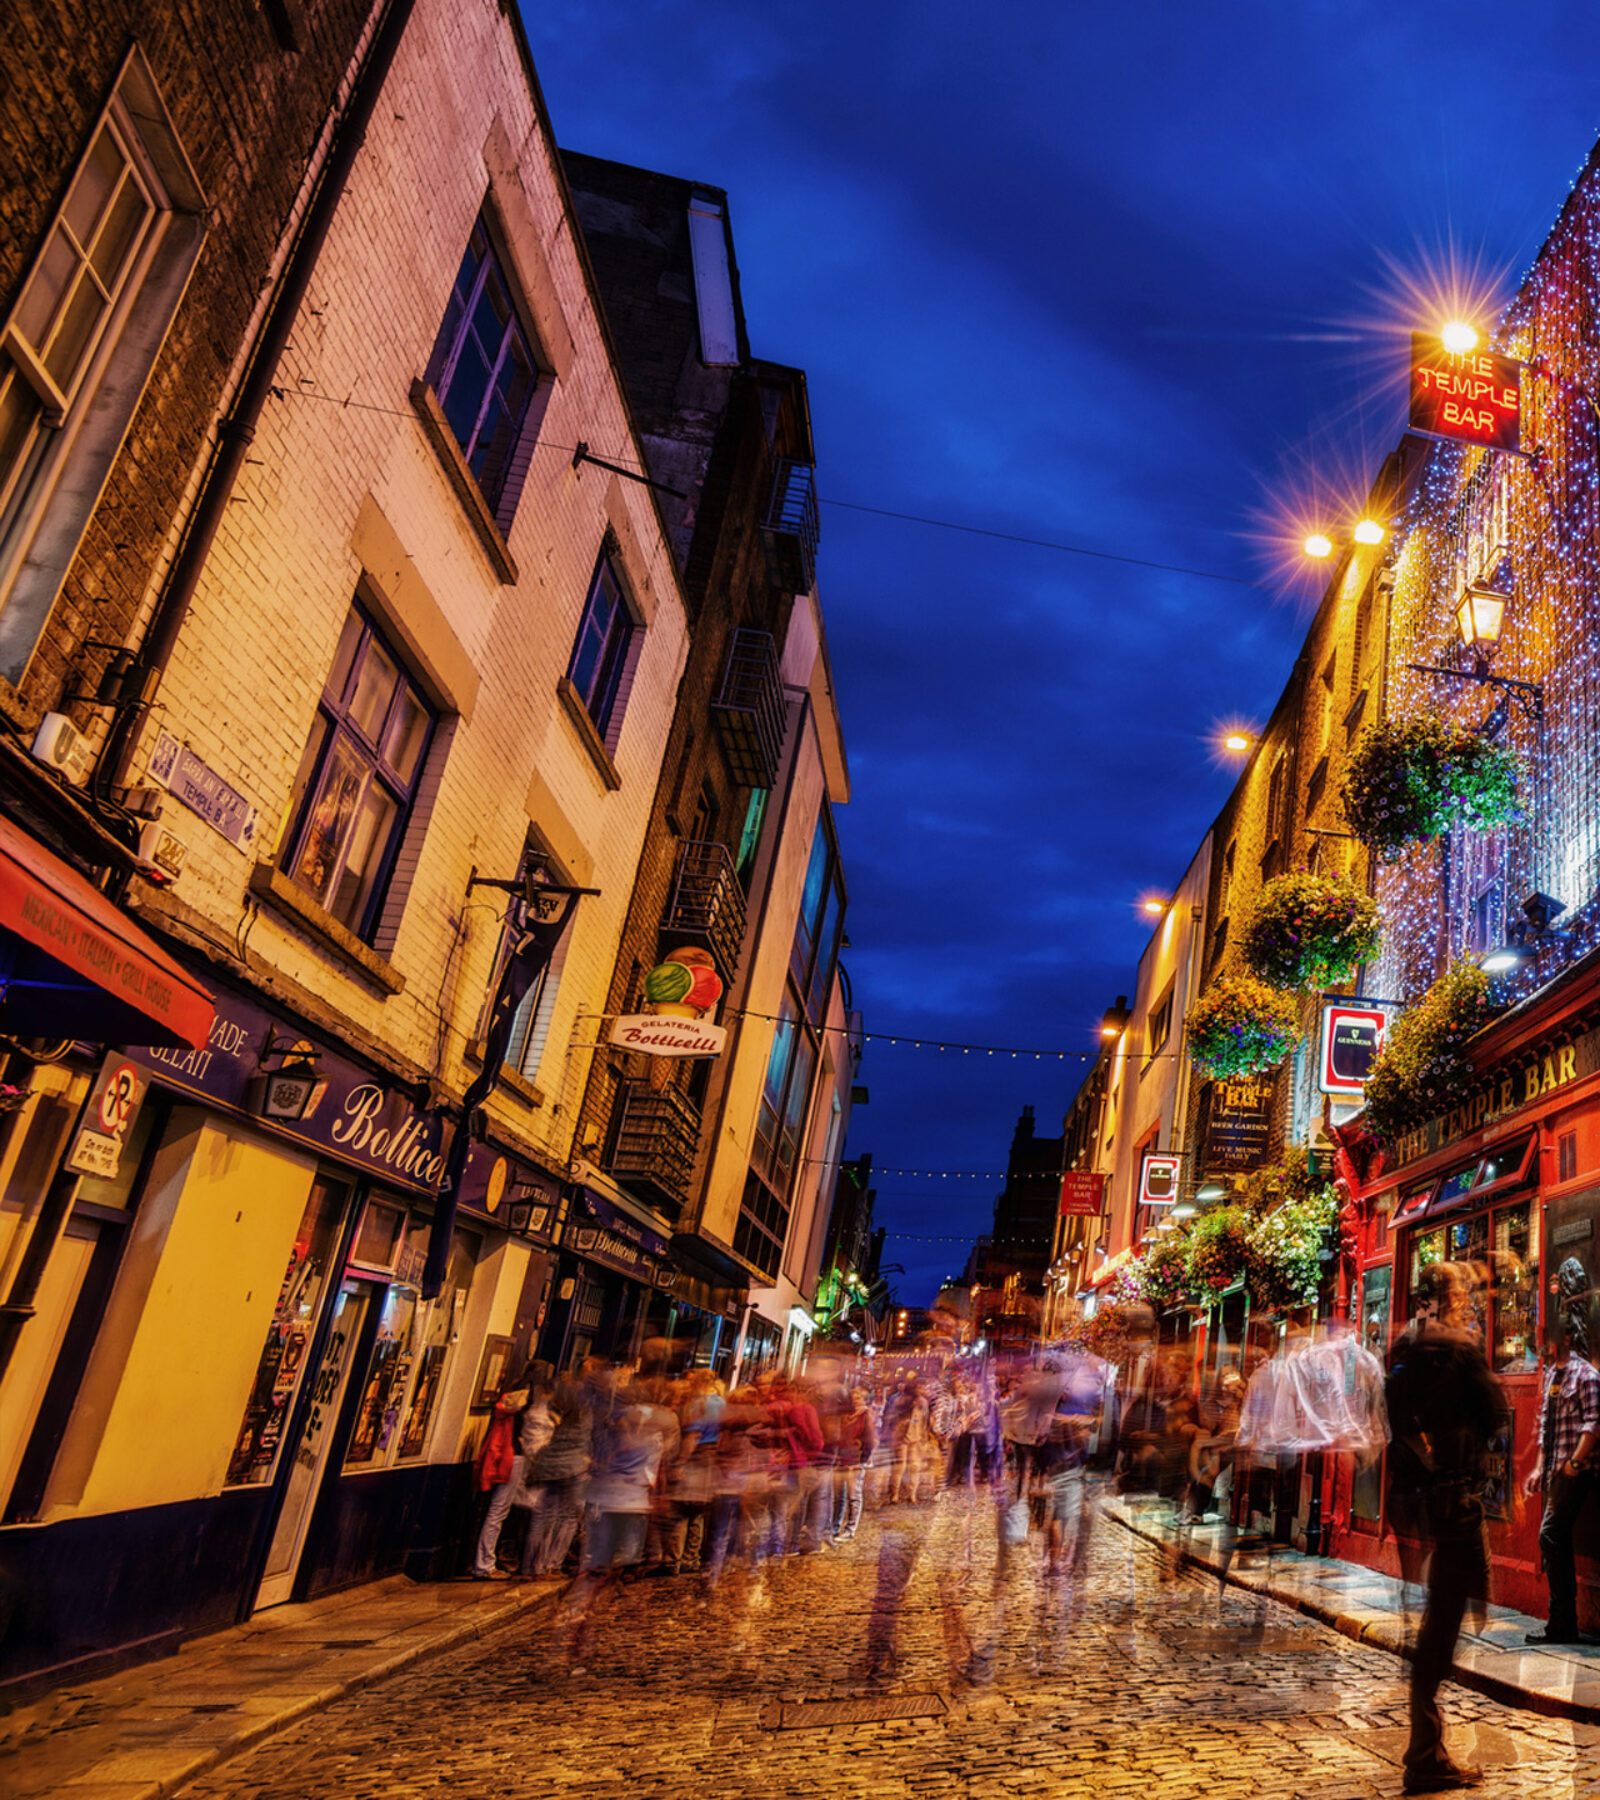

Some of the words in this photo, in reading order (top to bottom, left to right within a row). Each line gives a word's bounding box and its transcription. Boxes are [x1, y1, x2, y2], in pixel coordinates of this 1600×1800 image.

[1418, 366, 1518, 410] TEMPLE
[1443, 402, 1495, 433] BAR
[182, 780, 213, 817] TEMPLE
[77, 931, 116, 976] ITALIAN
[208, 1014, 250, 1058] ADE
[621, 1027, 719, 1052] Botticelli
[640, 1020, 701, 1035] GELATERIA
[1213, 1080, 1273, 1099] TEMPLE
[1224, 1092, 1259, 1108] BAR
[1397, 1122, 1431, 1166] THE
[1436, 1078, 1515, 1147] TEMPLE
[1524, 1044, 1577, 1102] BAR
[331, 1083, 474, 1188] Bottice
